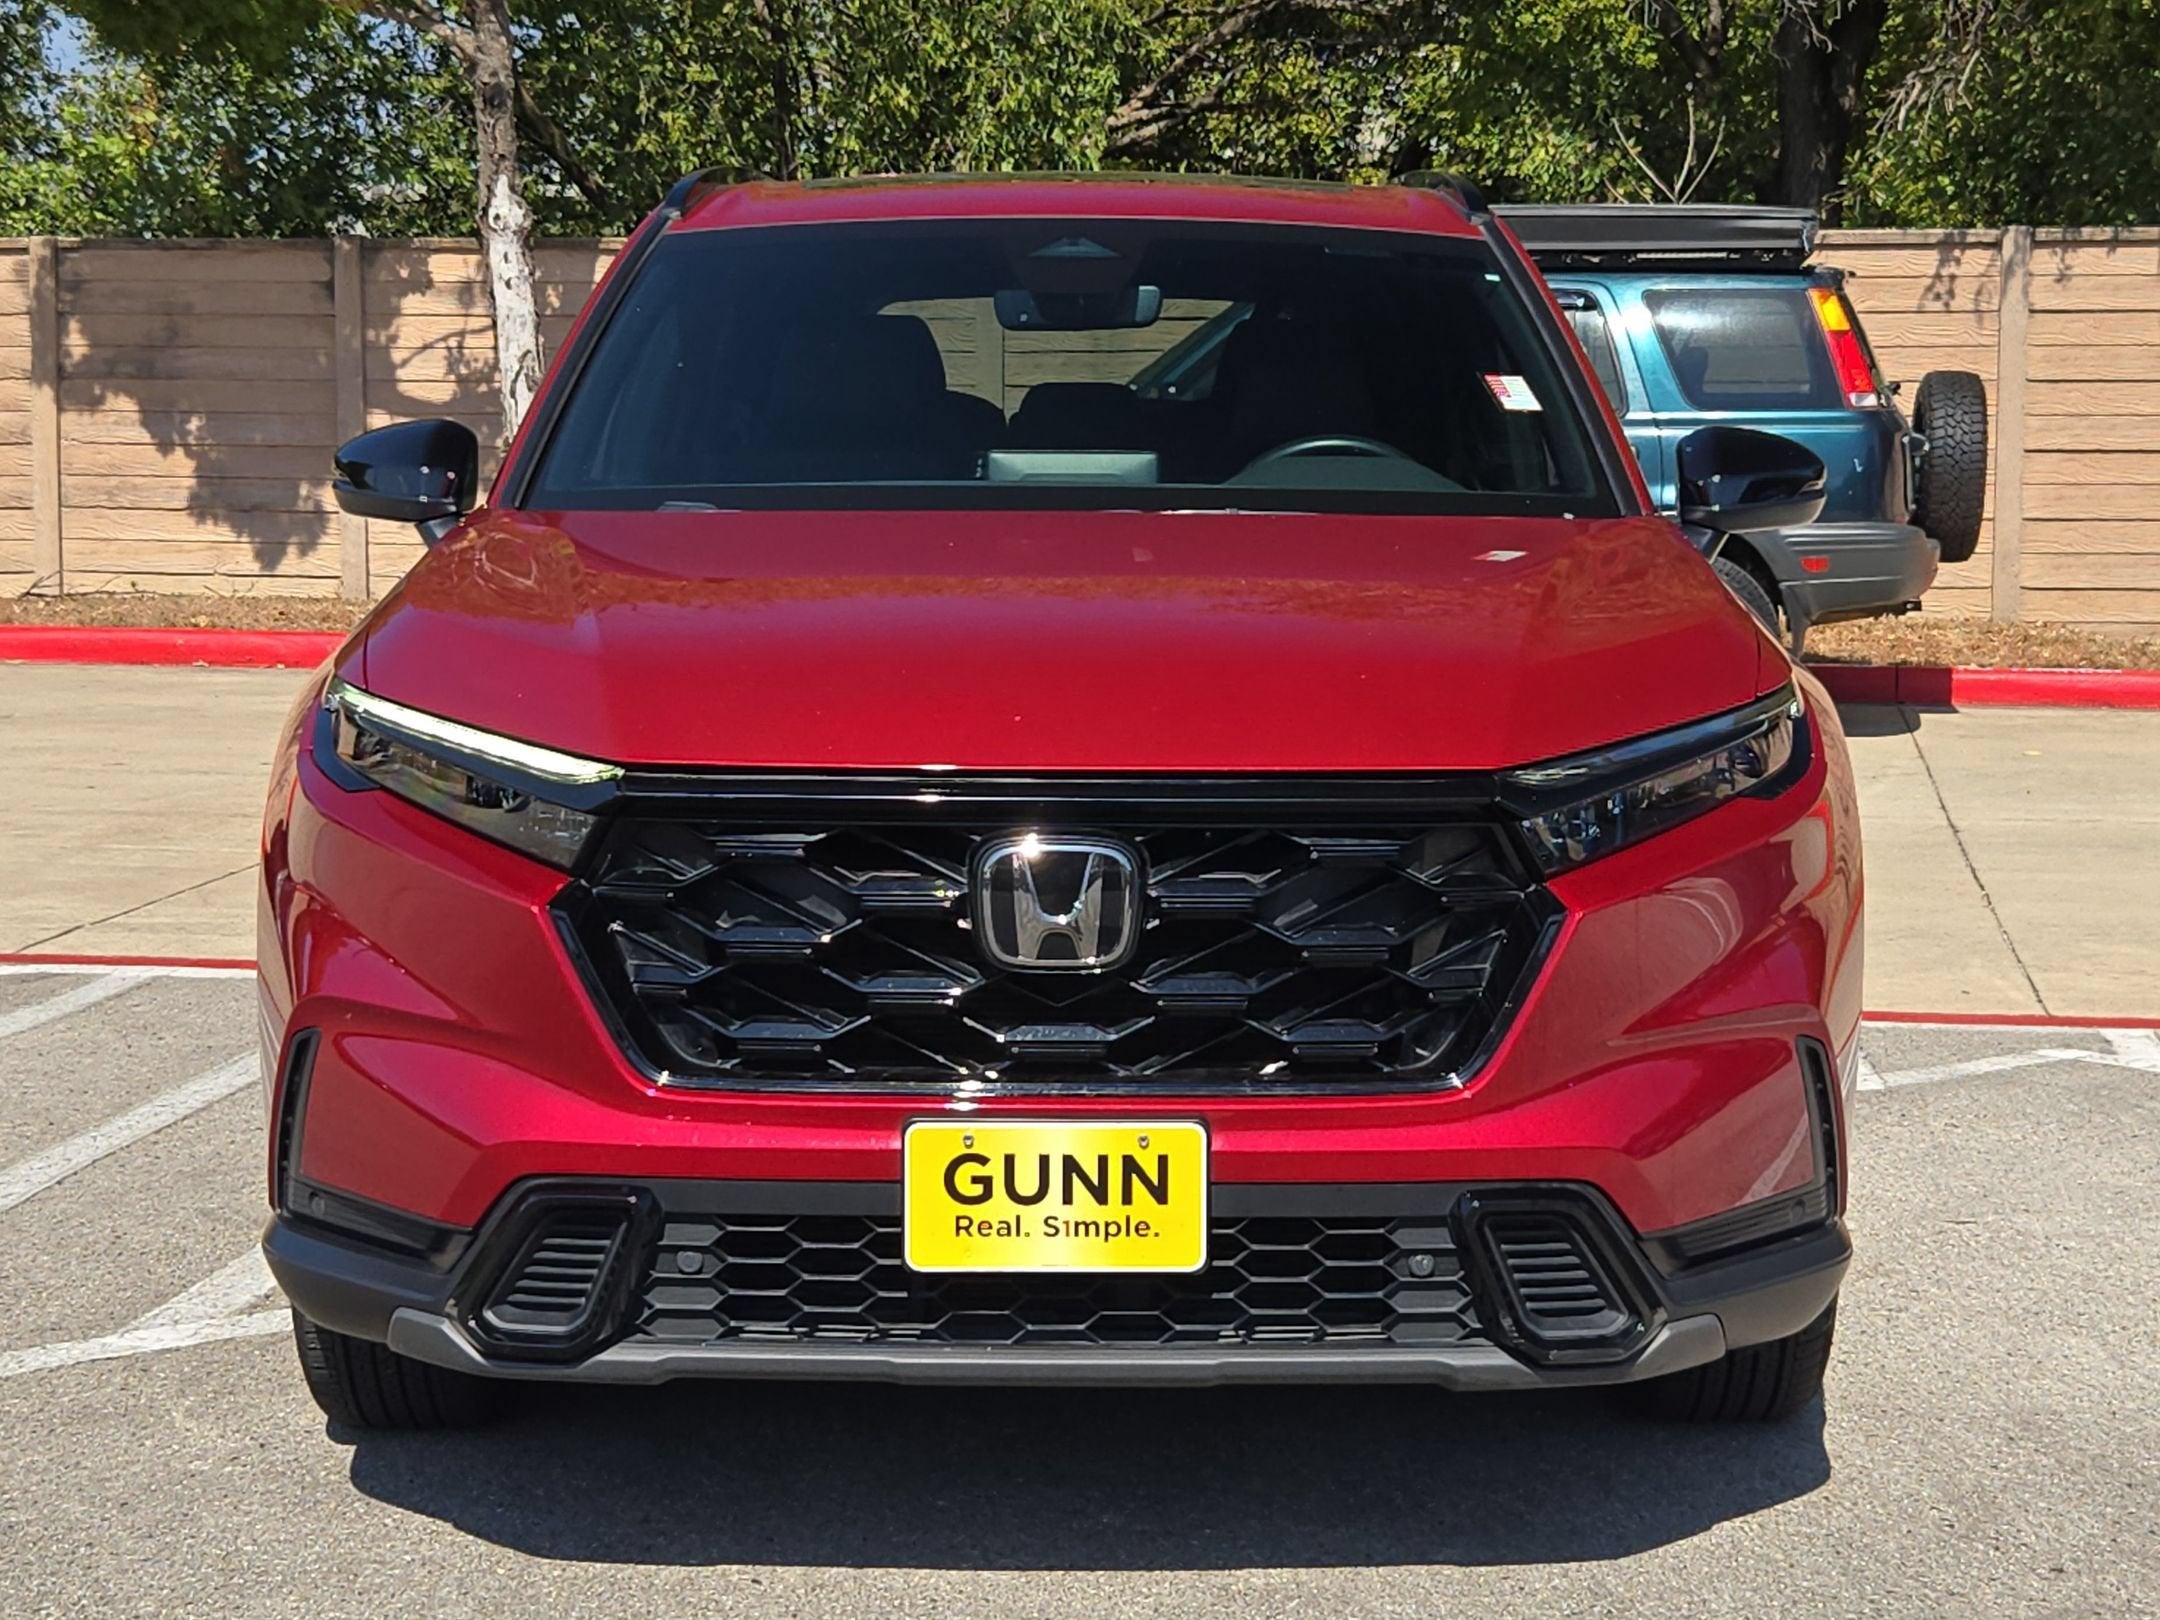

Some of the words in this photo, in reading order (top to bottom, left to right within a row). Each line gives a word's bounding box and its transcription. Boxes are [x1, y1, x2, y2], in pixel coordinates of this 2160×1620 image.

[943, 1153, 1169, 1206] GUNN
[955, 1215, 1030, 1237] Real.
[1043, 1215, 1160, 1243] Simple.
